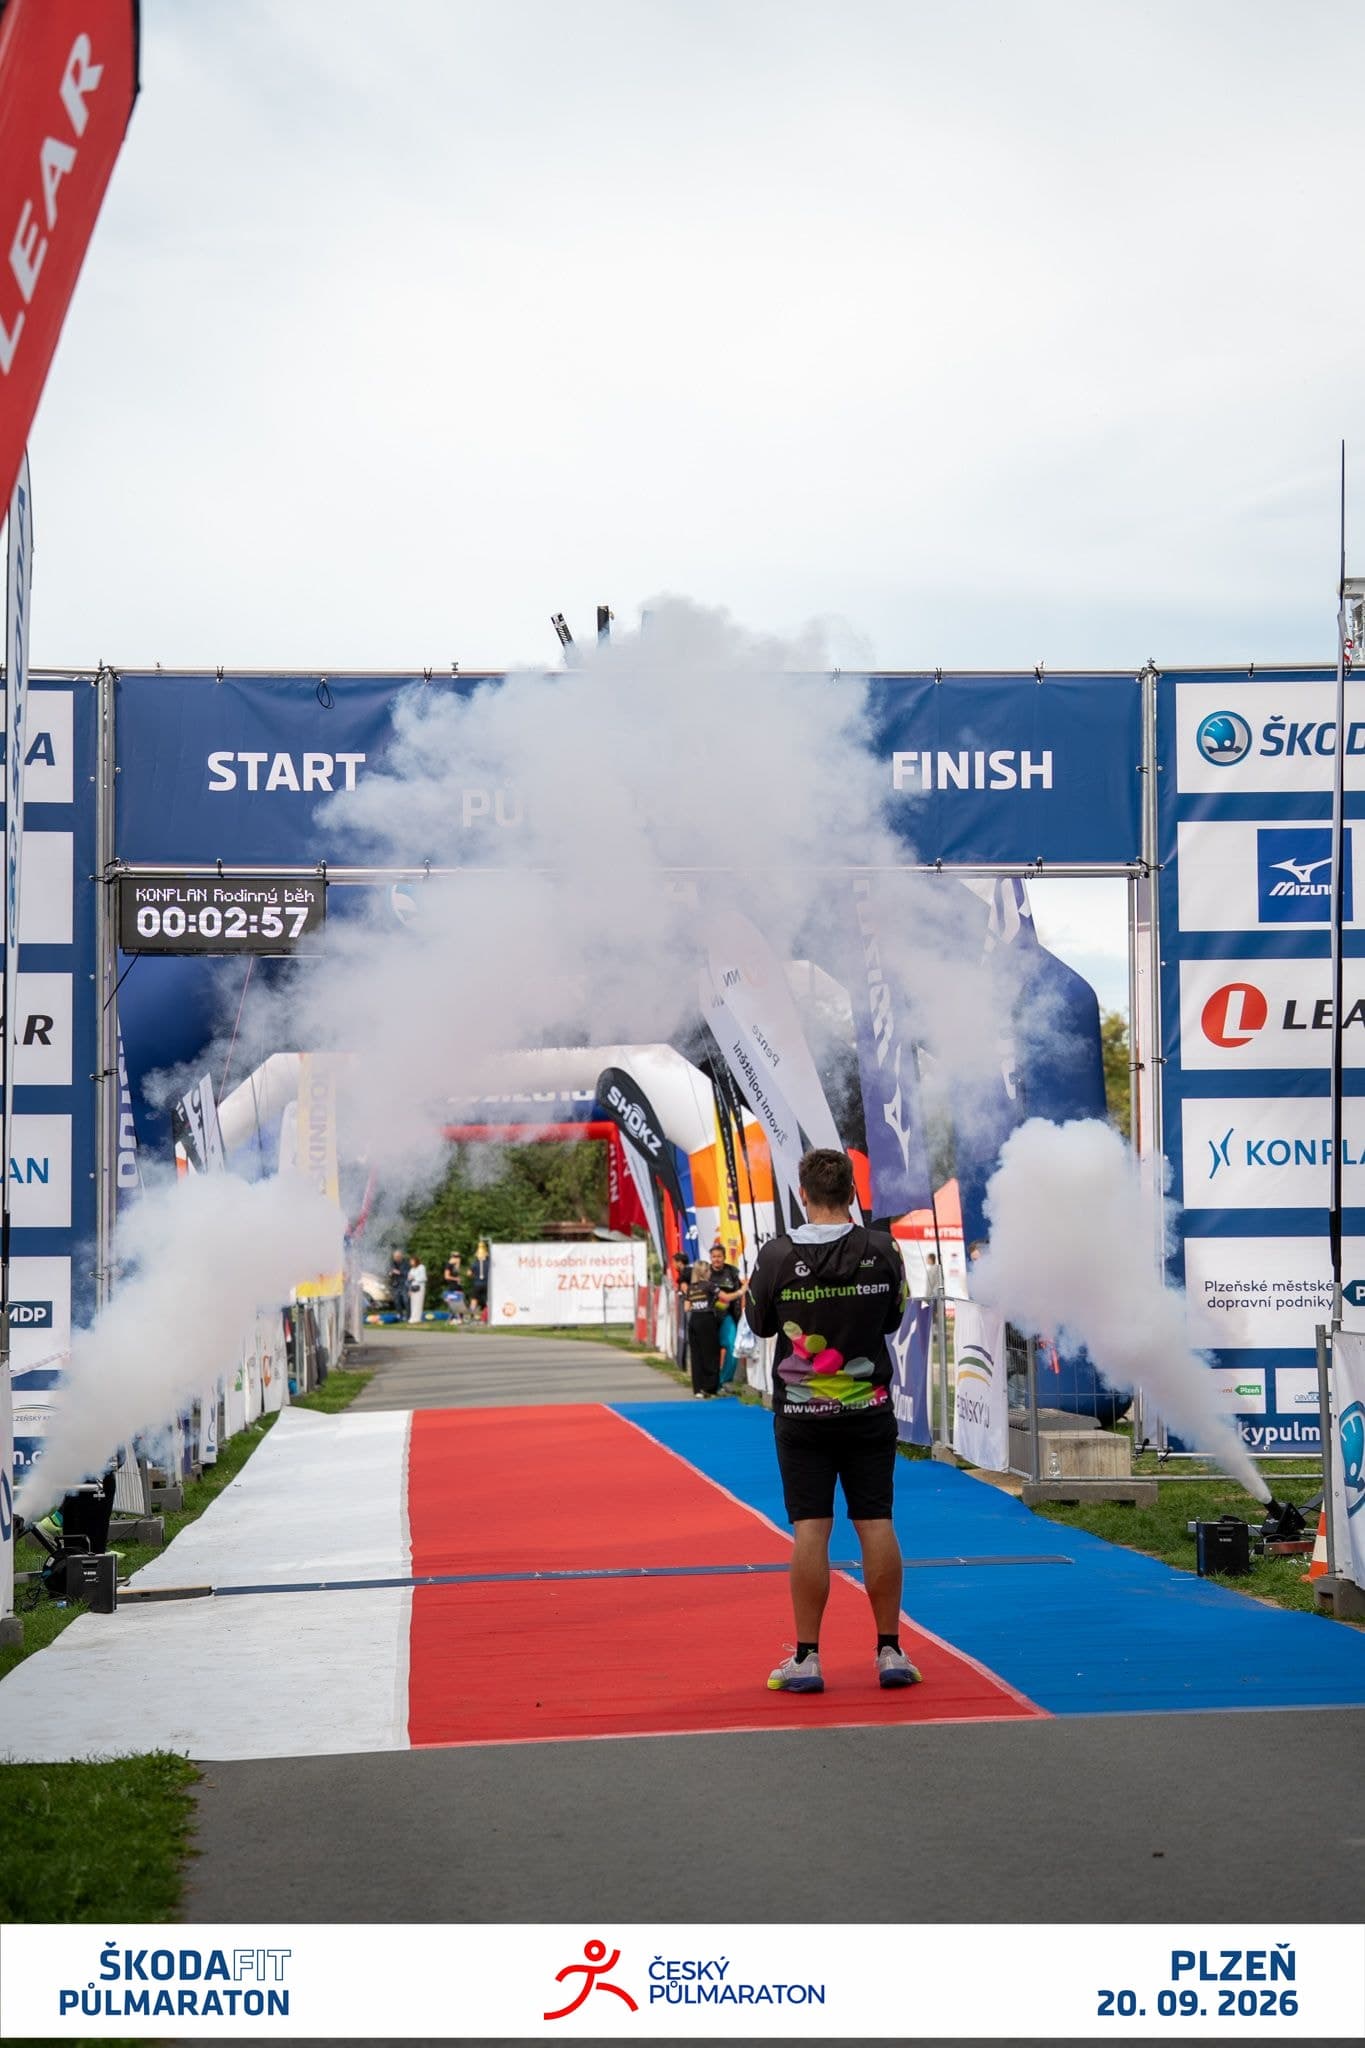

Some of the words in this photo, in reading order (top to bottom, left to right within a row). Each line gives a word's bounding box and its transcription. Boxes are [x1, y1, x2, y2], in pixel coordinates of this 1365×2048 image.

[0, 33, 103, 374] LEAR
[207, 751, 366, 792] START
[892, 750, 1053, 790] FINISH
[136, 888, 208, 902] KONPLAN
[213, 887, 278, 904] Rodinný
[284, 887, 315, 902] běh
[137, 906, 309, 938] 00:02:57
[607, 1085, 663, 1156] SHOKZ
[1246, 1139, 1365, 1166] KONPL
[781, 1283, 890, 1302] #nightrunteam
[1204, 1280, 1268, 1292] Plzeňské
[1272, 1279, 1334, 1292] městské
[1207, 1295, 1271, 1311] dopravní
[1276, 1295, 1334, 1311] podniky
